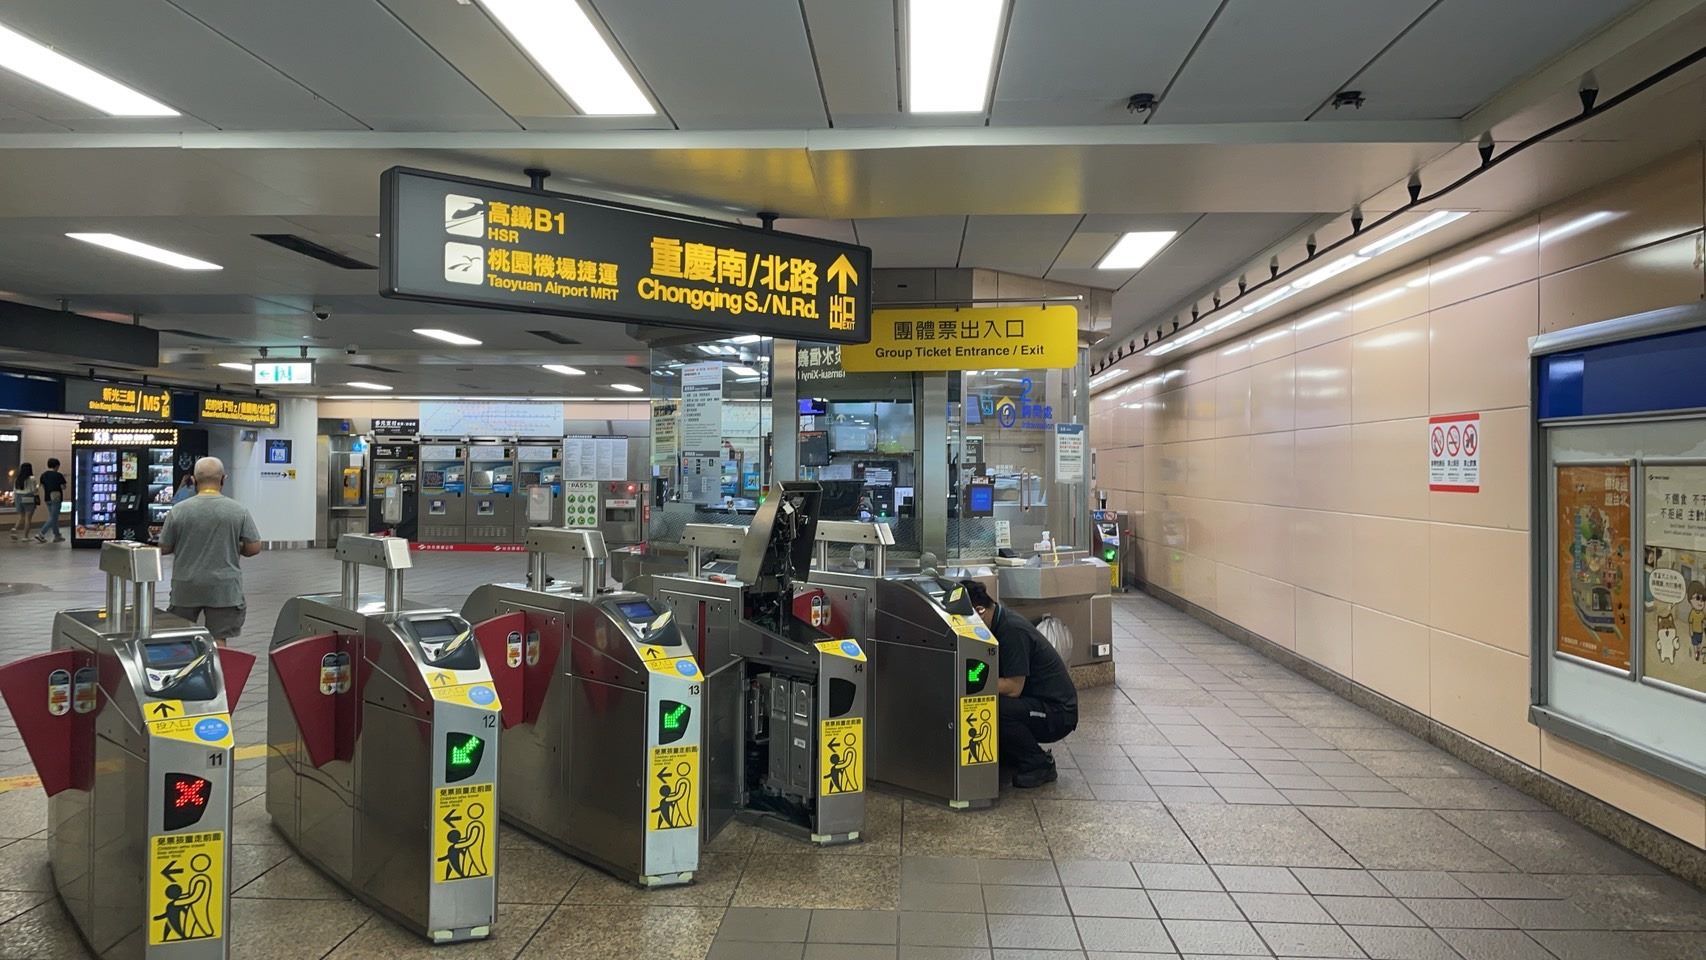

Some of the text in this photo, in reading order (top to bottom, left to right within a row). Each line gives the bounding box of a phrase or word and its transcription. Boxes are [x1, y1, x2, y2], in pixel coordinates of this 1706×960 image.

[488, 201, 565, 235] 高鐵B1
[488, 228, 519, 244] HSR
[488, 248, 618, 286] 桃園機場捷運
[650, 236, 818, 296] 重慶南/北路
[488, 274, 618, 300] Taoyuan Airport MRT
[638, 277, 742, 314] Chongqing
[829, 294, 856, 330] 出口
[894, 320, 1025, 340] 團體票出入口
[875, 344, 1044, 360] Group Ticket Entrance / Exit
[143, 394, 160, 412] M5
[1688, 508, 1706, 522] 主動
[987, 648, 996, 656] 15
[854, 664, 862, 672] 14
[689, 686, 700, 696] 13
[482, 714, 496, 728] 12
[209, 753, 222, 766] 11
